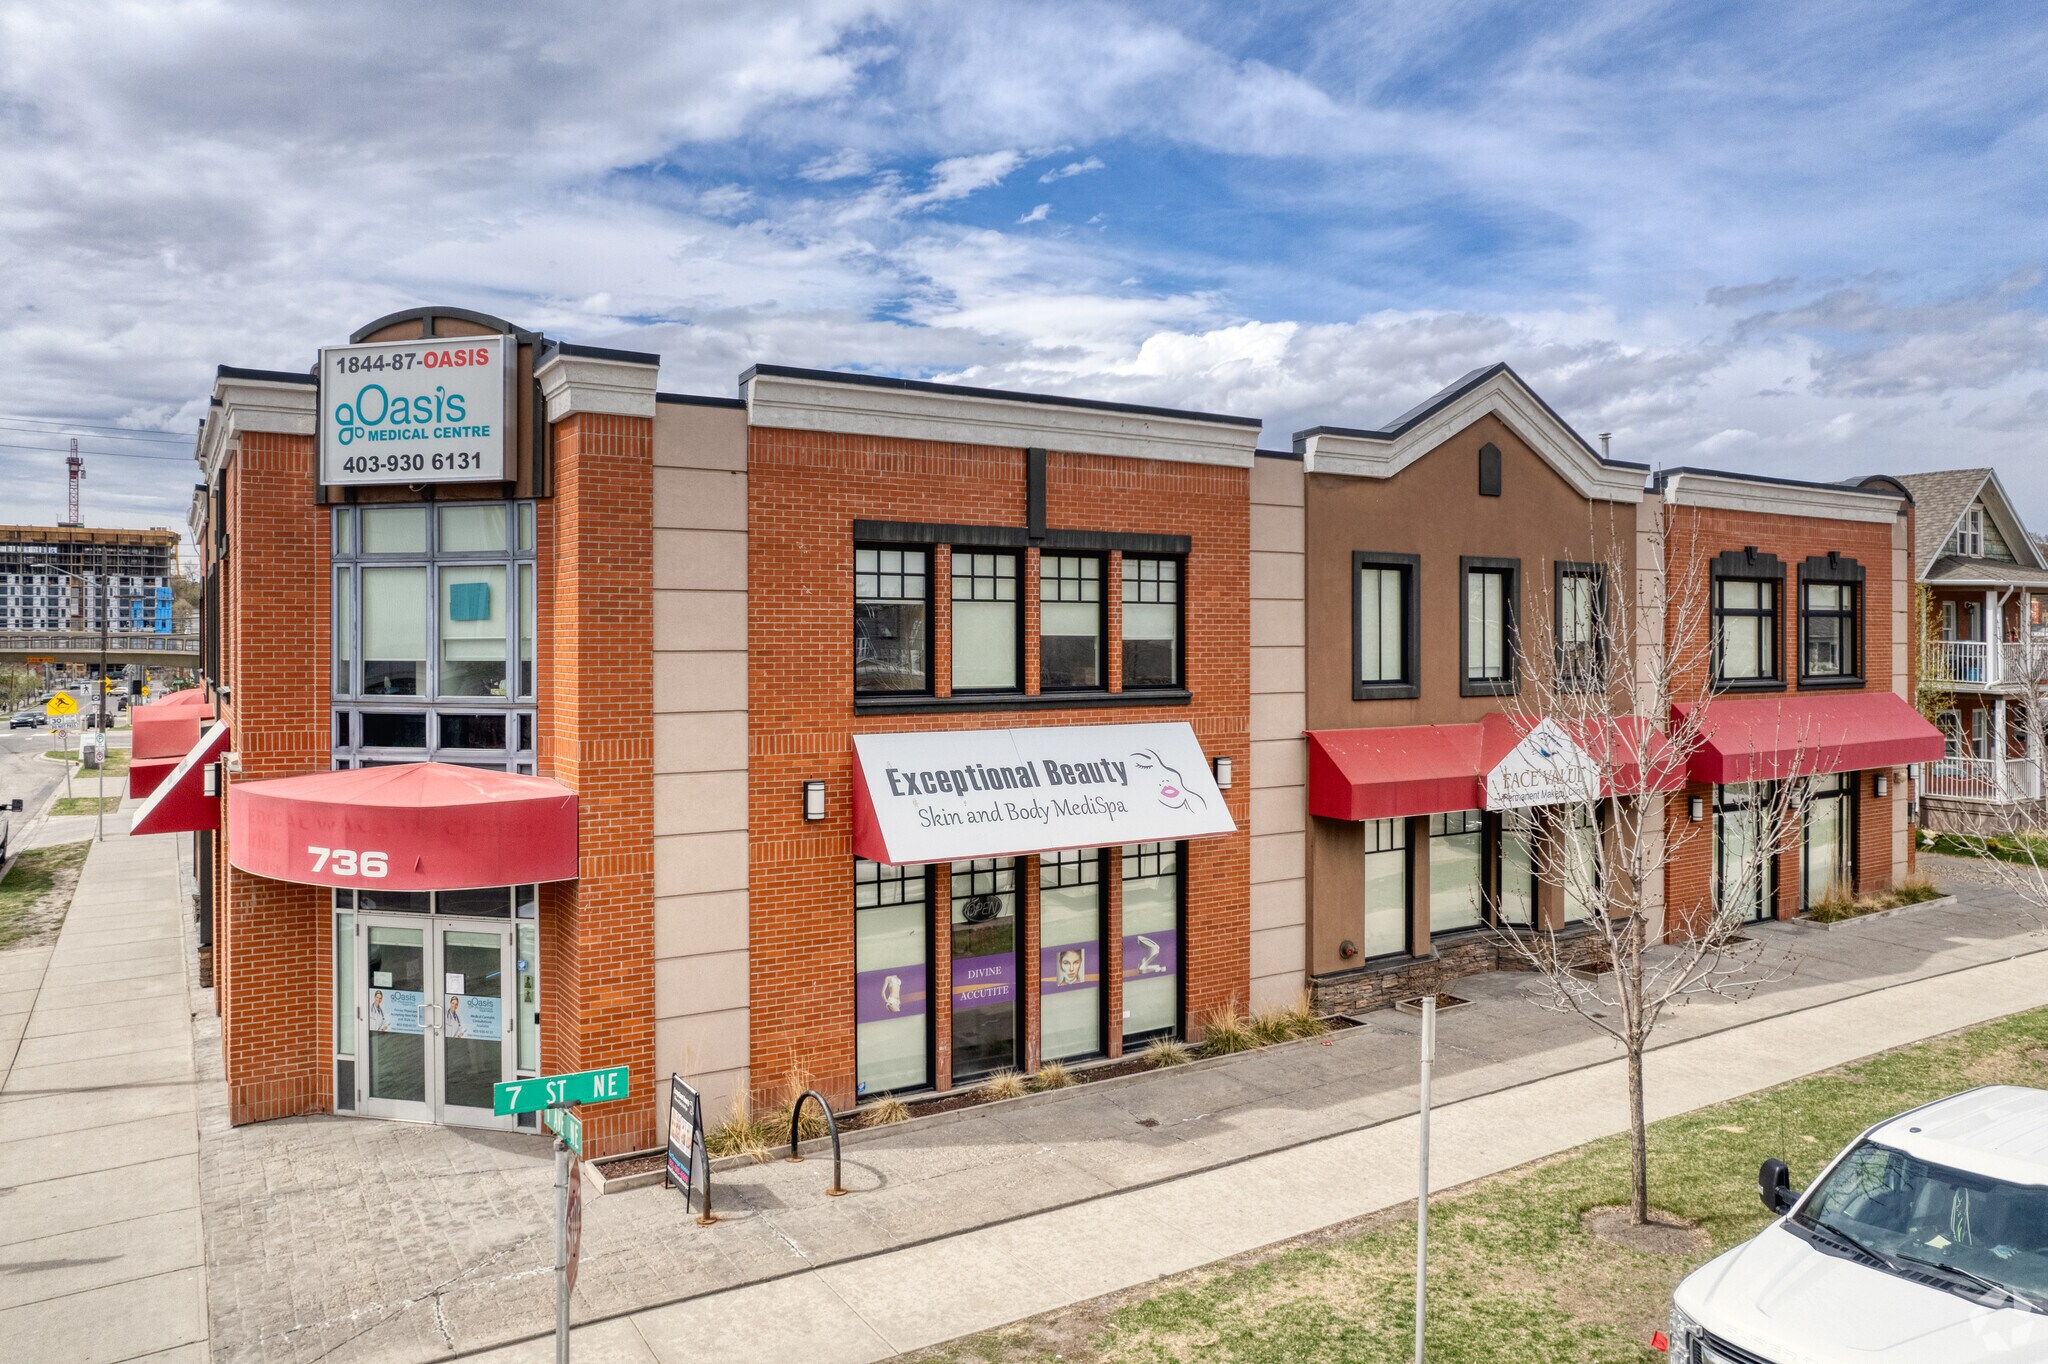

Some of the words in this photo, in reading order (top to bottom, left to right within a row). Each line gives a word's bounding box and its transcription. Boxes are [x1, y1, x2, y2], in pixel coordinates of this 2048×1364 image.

[336, 348, 489, 374] 1844-87-OASIS
[356, 384, 466, 426] Oasis
[368, 428, 429, 442] MEDICAL
[433, 425, 491, 439] CENTRE
[343, 453, 424, 474] 403-930
[431, 451, 481, 470] 6131
[885, 761, 1041, 797] Exceptional
[1042, 757, 1128, 787] Beauty
[1503, 771, 1539, 789] FACE
[918, 807, 964, 828] Skin
[967, 801, 1004, 823] and
[1006, 799, 1049, 824] Body
[1054, 796, 1128, 821] MediSpa
[308, 846, 389, 878] 736
[964, 900, 999, 917] OPEN
[967, 966, 1002, 979] DIVINE
[960, 985, 1009, 1001] ACCUTITE
[505, 1085, 523, 1110] 7
[546, 1080, 567, 1105] ST
[593, 1072, 618, 1098] NE
[570, 1119, 580, 1150] NE
